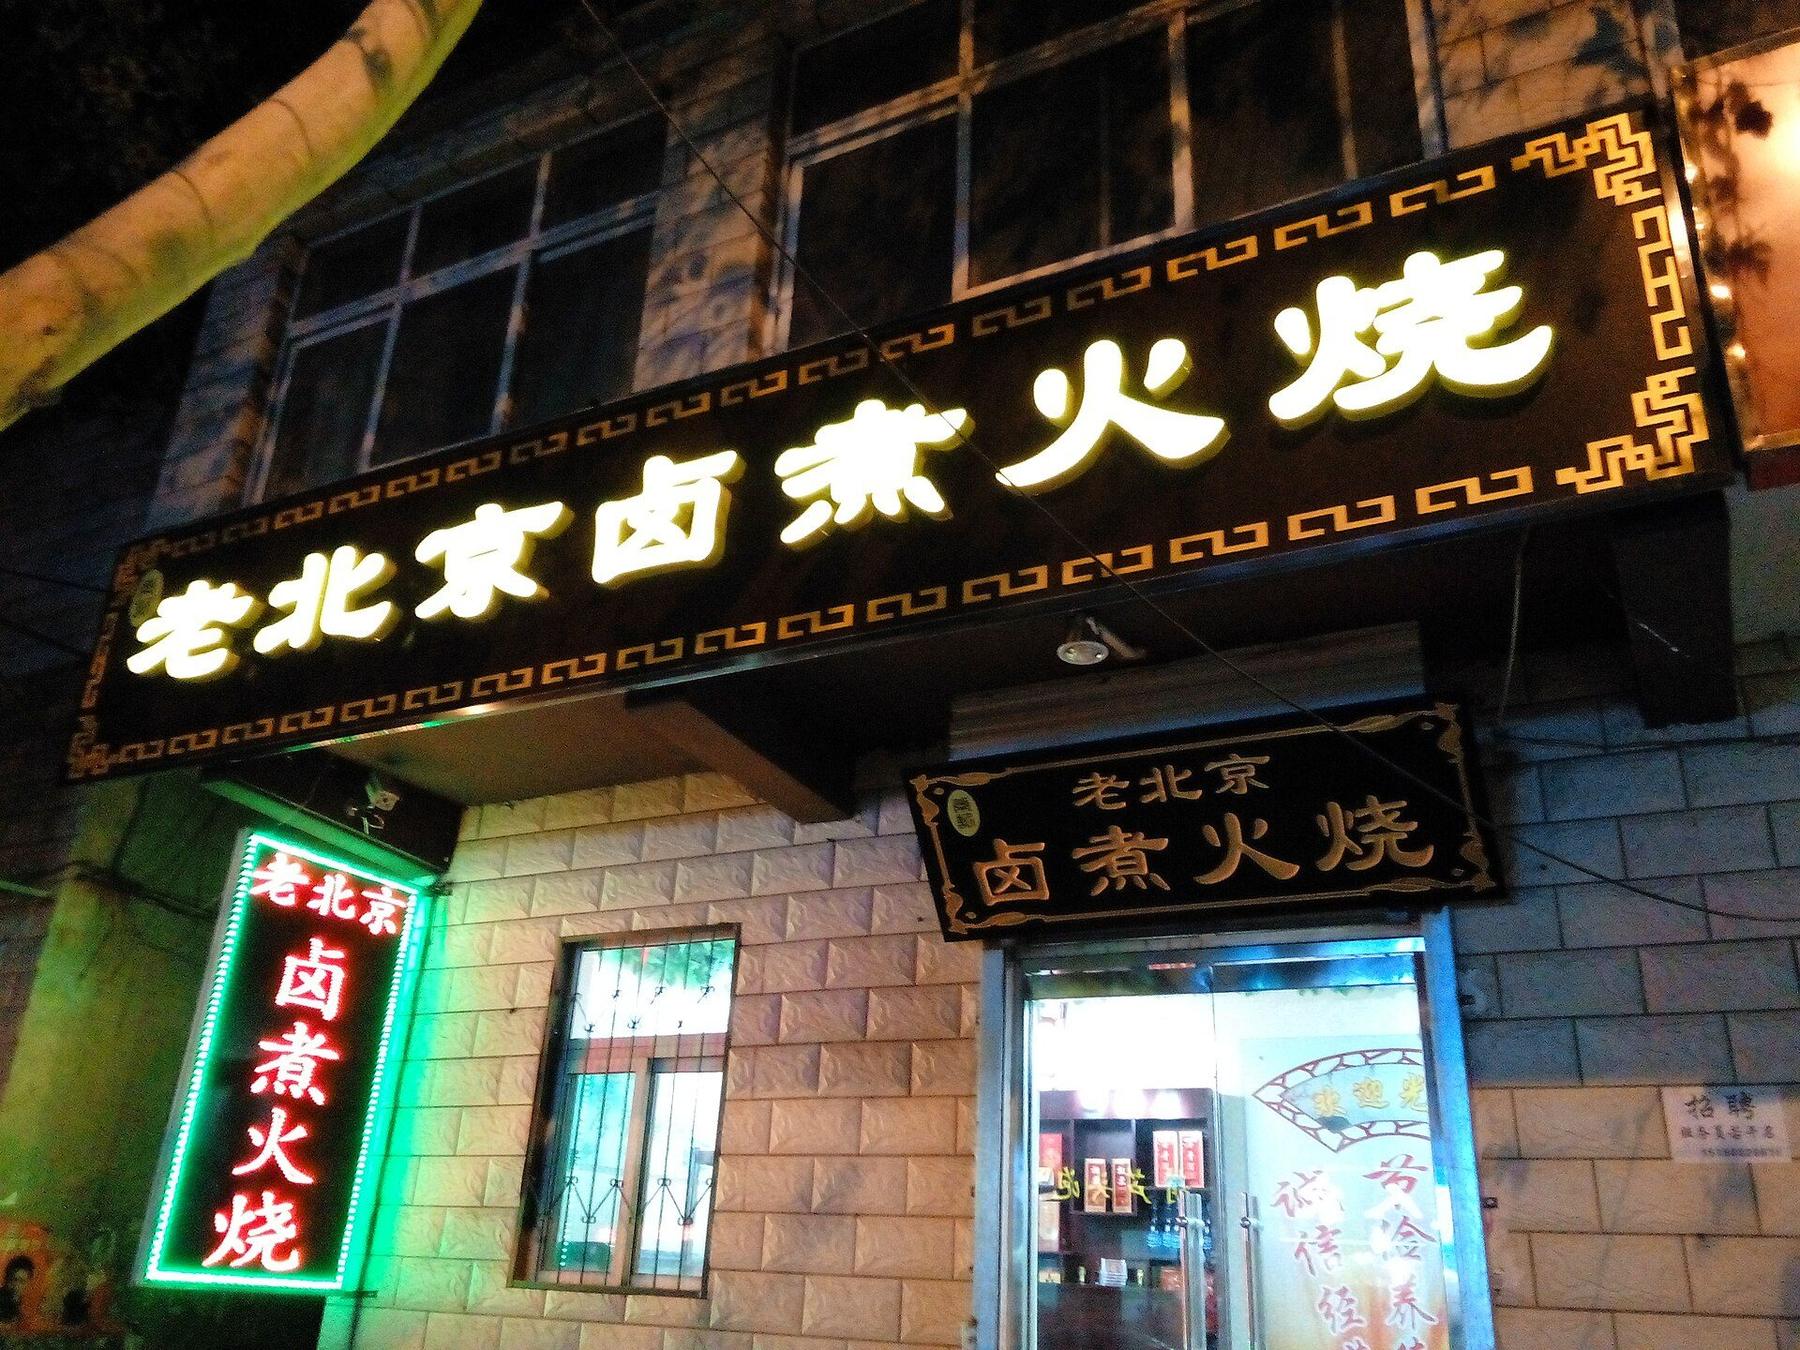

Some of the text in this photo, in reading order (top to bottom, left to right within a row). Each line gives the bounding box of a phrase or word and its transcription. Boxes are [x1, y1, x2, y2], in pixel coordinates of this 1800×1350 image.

[126, 249, 1554, 681] 老北京卤煮火烧
[972, 795, 1435, 907] 卤煮火烧
[1072, 753, 1270, 811] 老北京
[249, 853, 405, 935] 老北京
[202, 937, 345, 1273] 卤煮火烧
[1270, 1170, 1371, 1350] 诚信经
